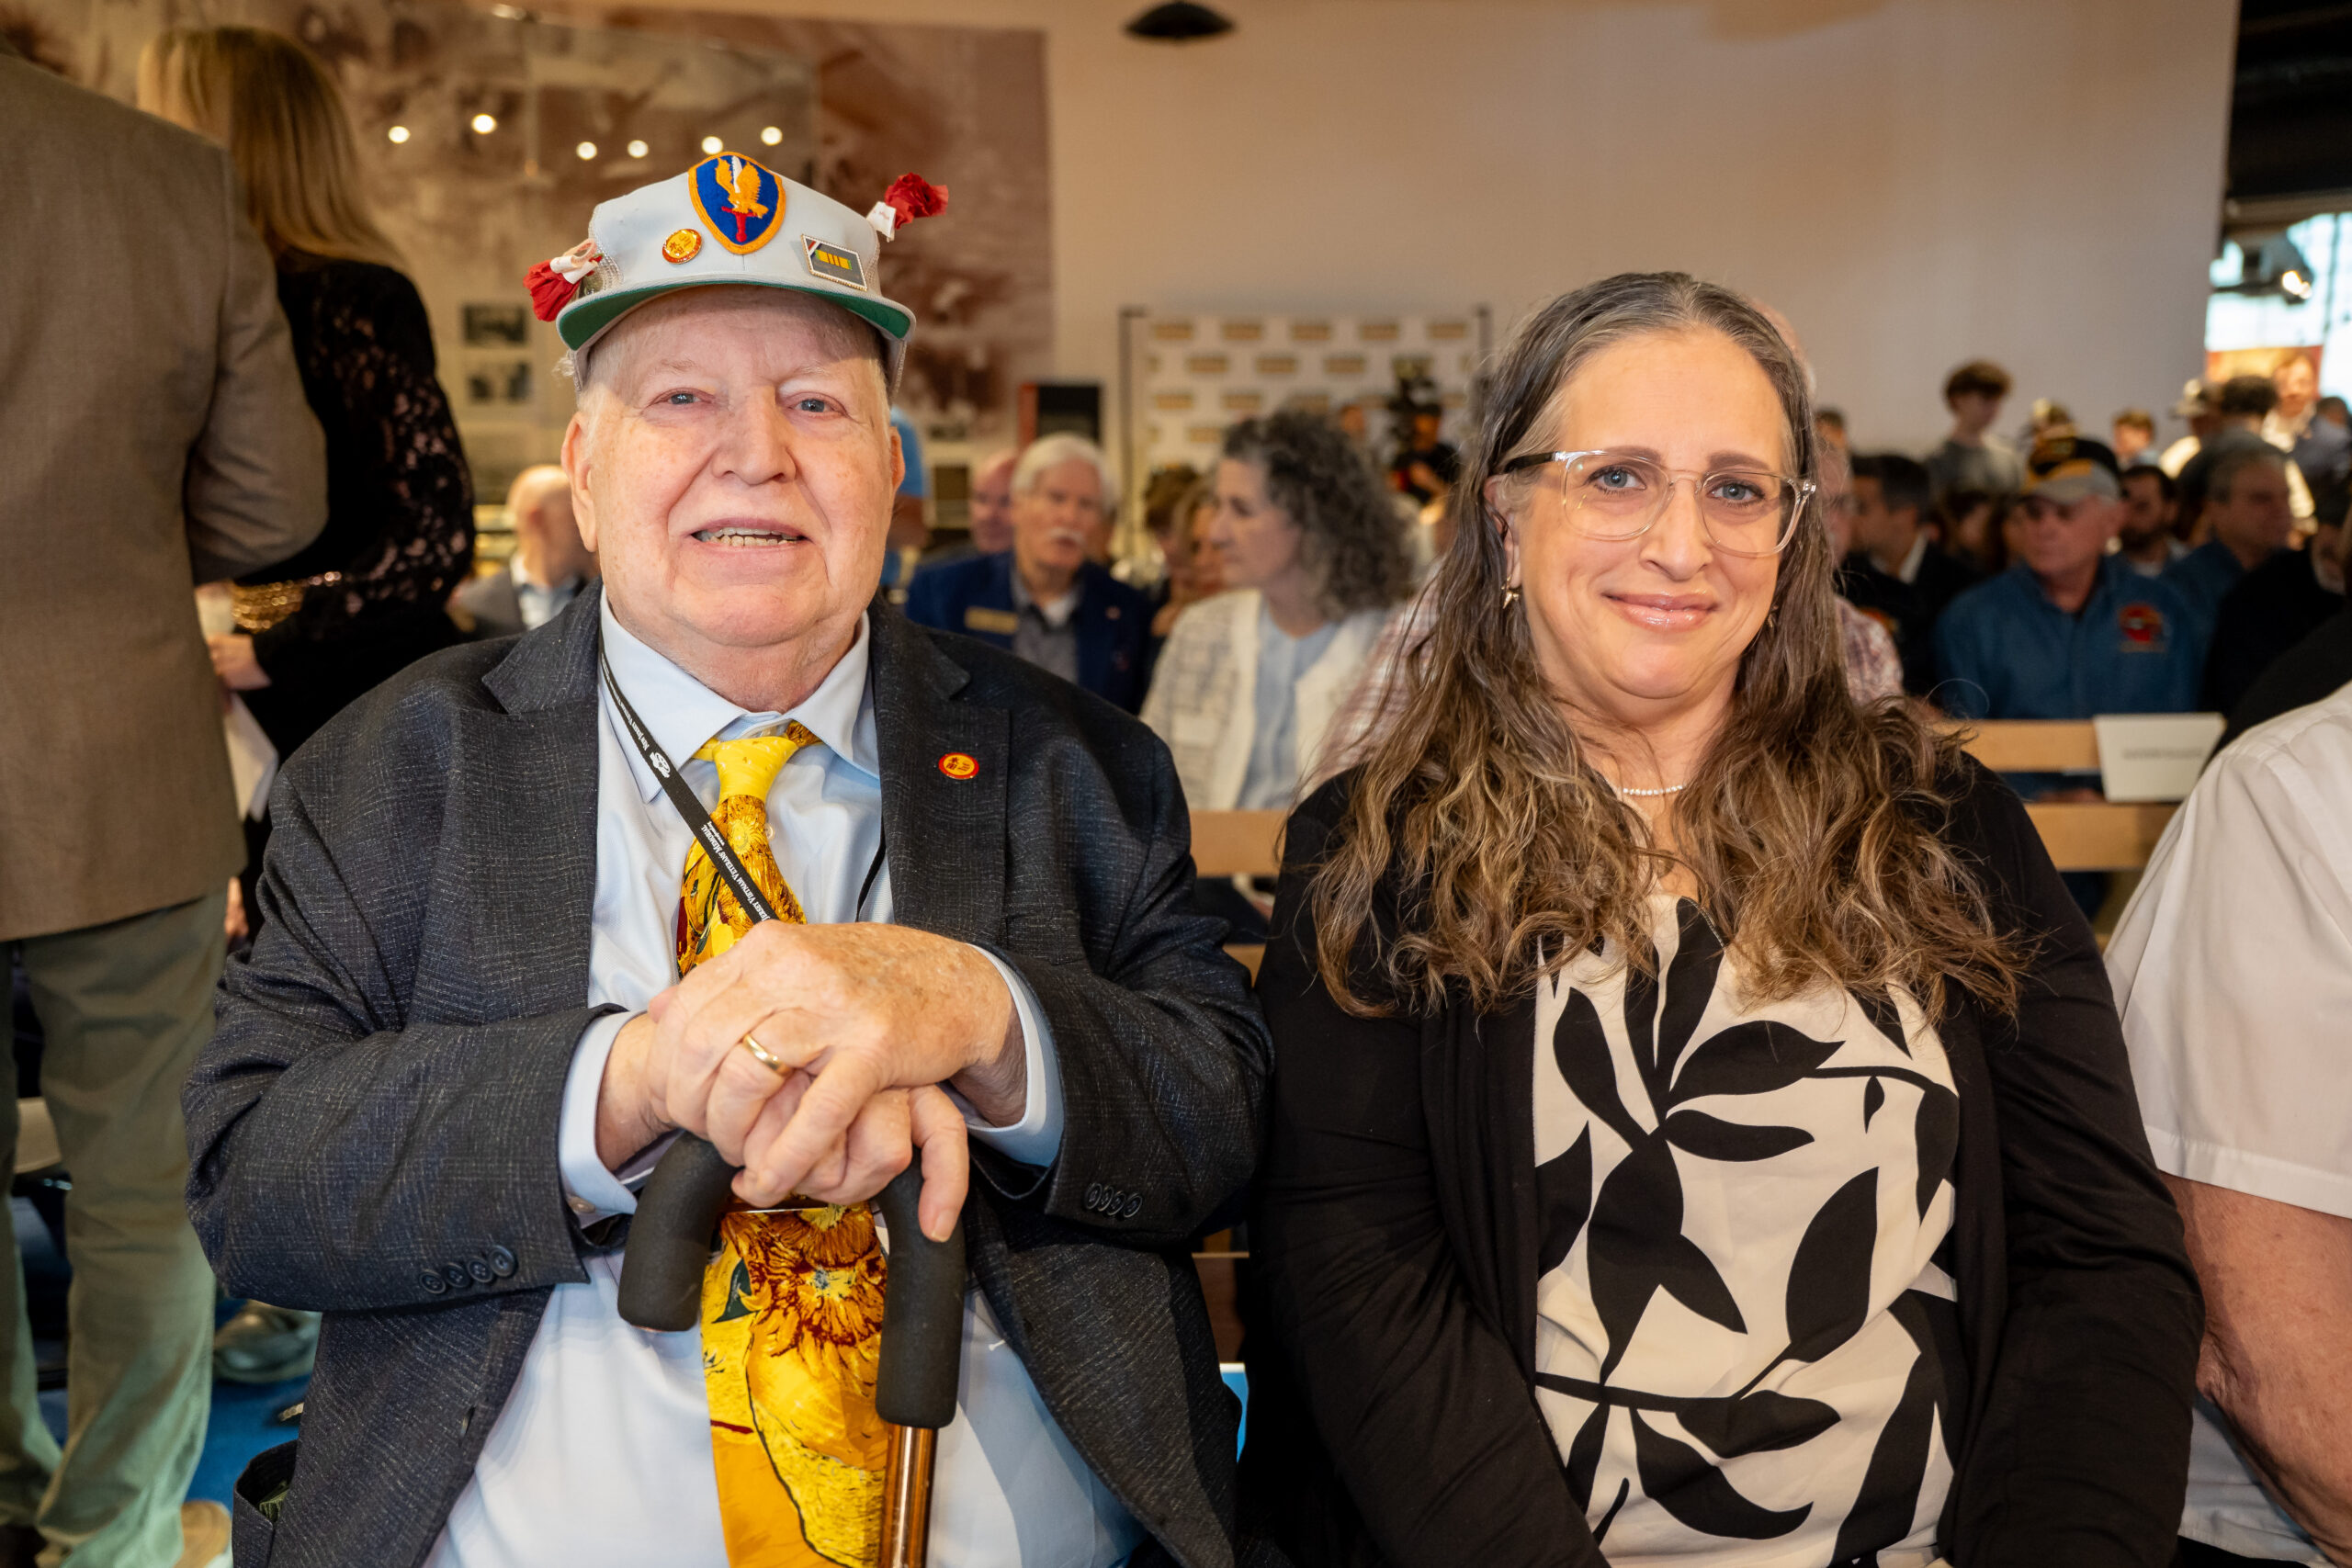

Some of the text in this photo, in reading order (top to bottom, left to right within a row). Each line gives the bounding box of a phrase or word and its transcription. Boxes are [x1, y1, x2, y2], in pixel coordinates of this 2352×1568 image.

[701, 824, 723, 853] MEMORIAL
[736, 876, 756, 905] VIETNAM
[752, 901, 771, 921] JERSEY
